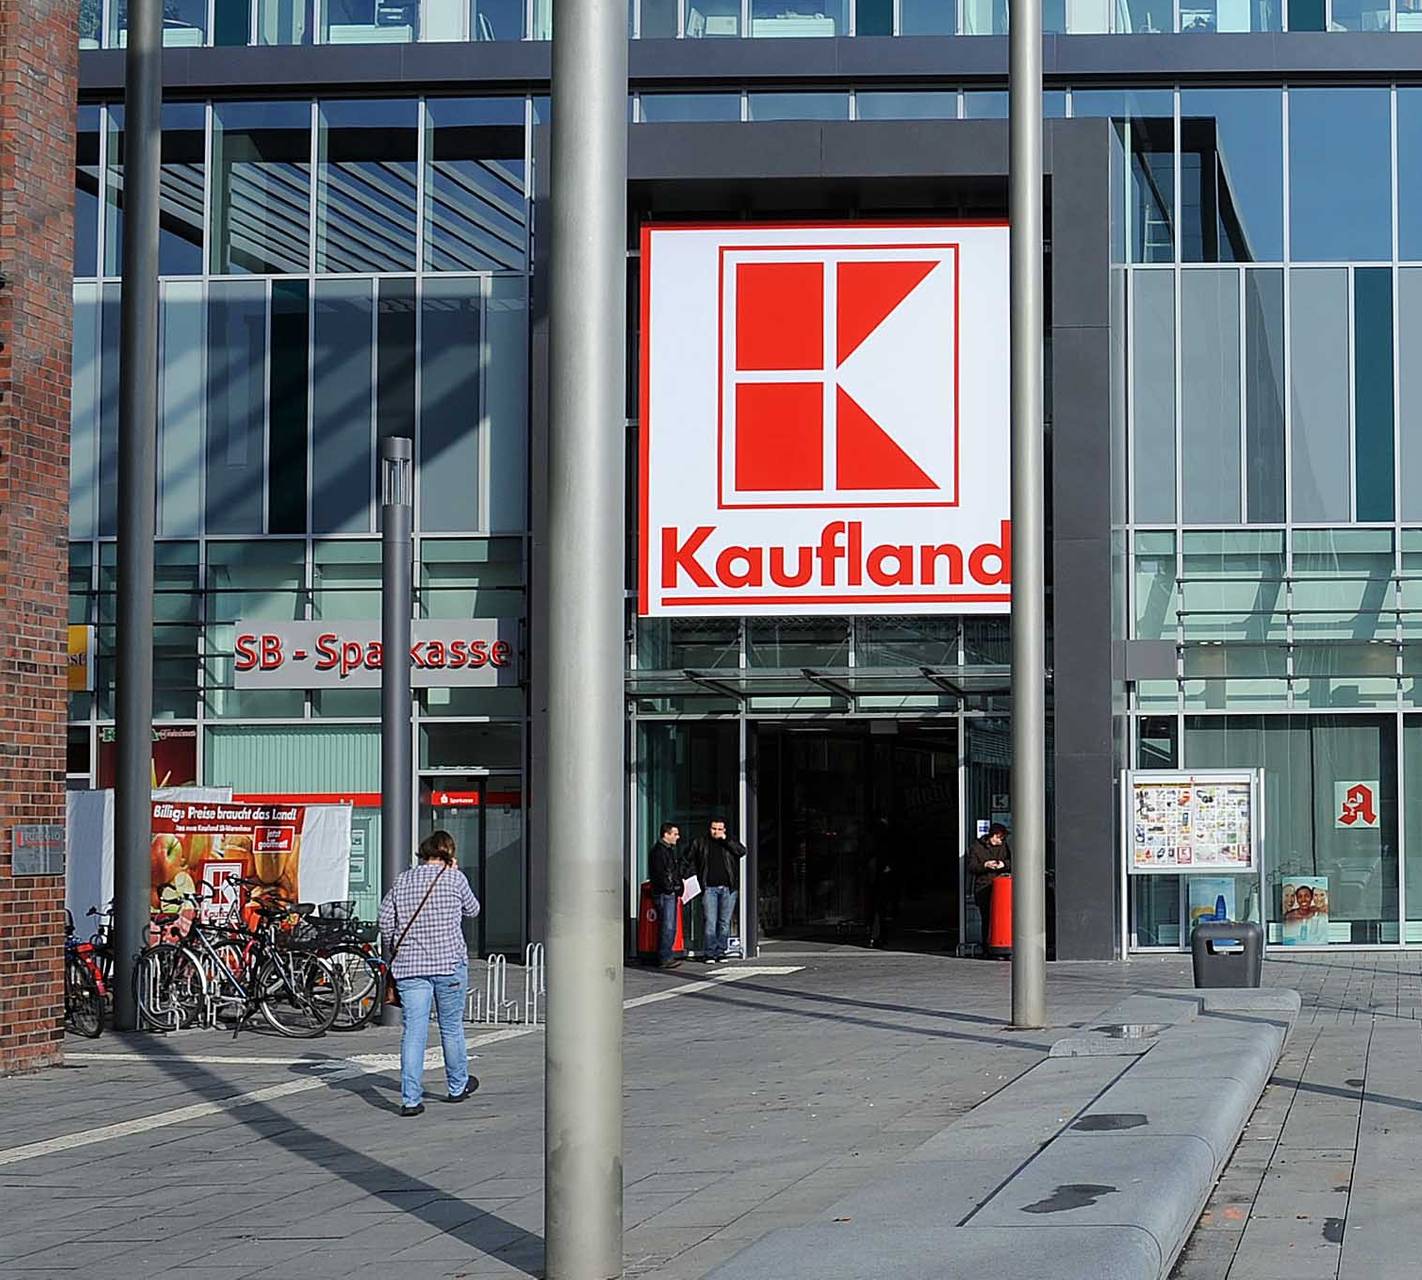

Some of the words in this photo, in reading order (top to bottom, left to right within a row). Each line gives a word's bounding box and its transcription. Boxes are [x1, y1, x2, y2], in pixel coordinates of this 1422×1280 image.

[661, 520, 1012, 590] Kaufland
[234, 634, 283, 669] SB
[315, 633, 512, 677] Spakasse
[187, 806, 216, 820] Preise
[217, 807, 251, 820] braucht
[252, 807, 270, 820] das
